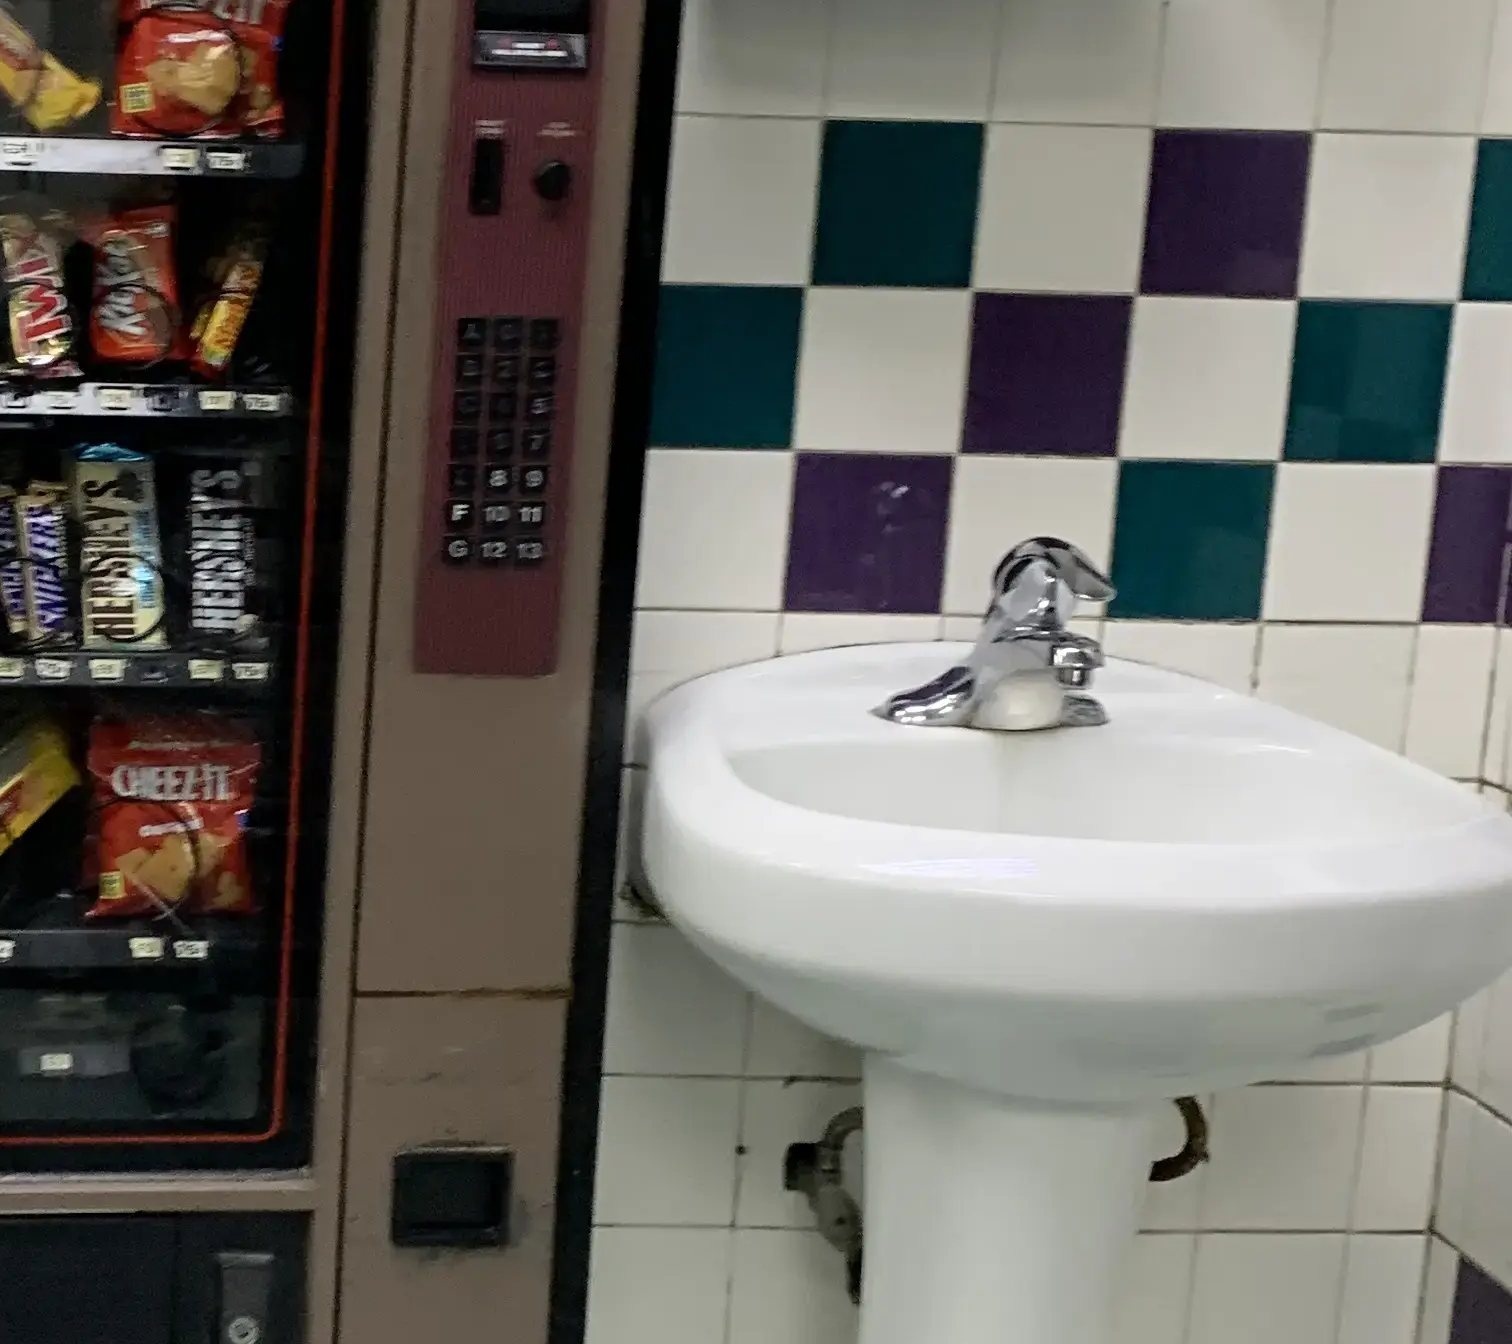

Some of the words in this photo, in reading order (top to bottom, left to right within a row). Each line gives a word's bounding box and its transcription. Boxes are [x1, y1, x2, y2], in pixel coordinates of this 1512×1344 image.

[451, 503, 470, 522] F
[519, 505, 544, 523] 11
[448, 539, 469, 558] G
[480, 541, 508, 558] 12
